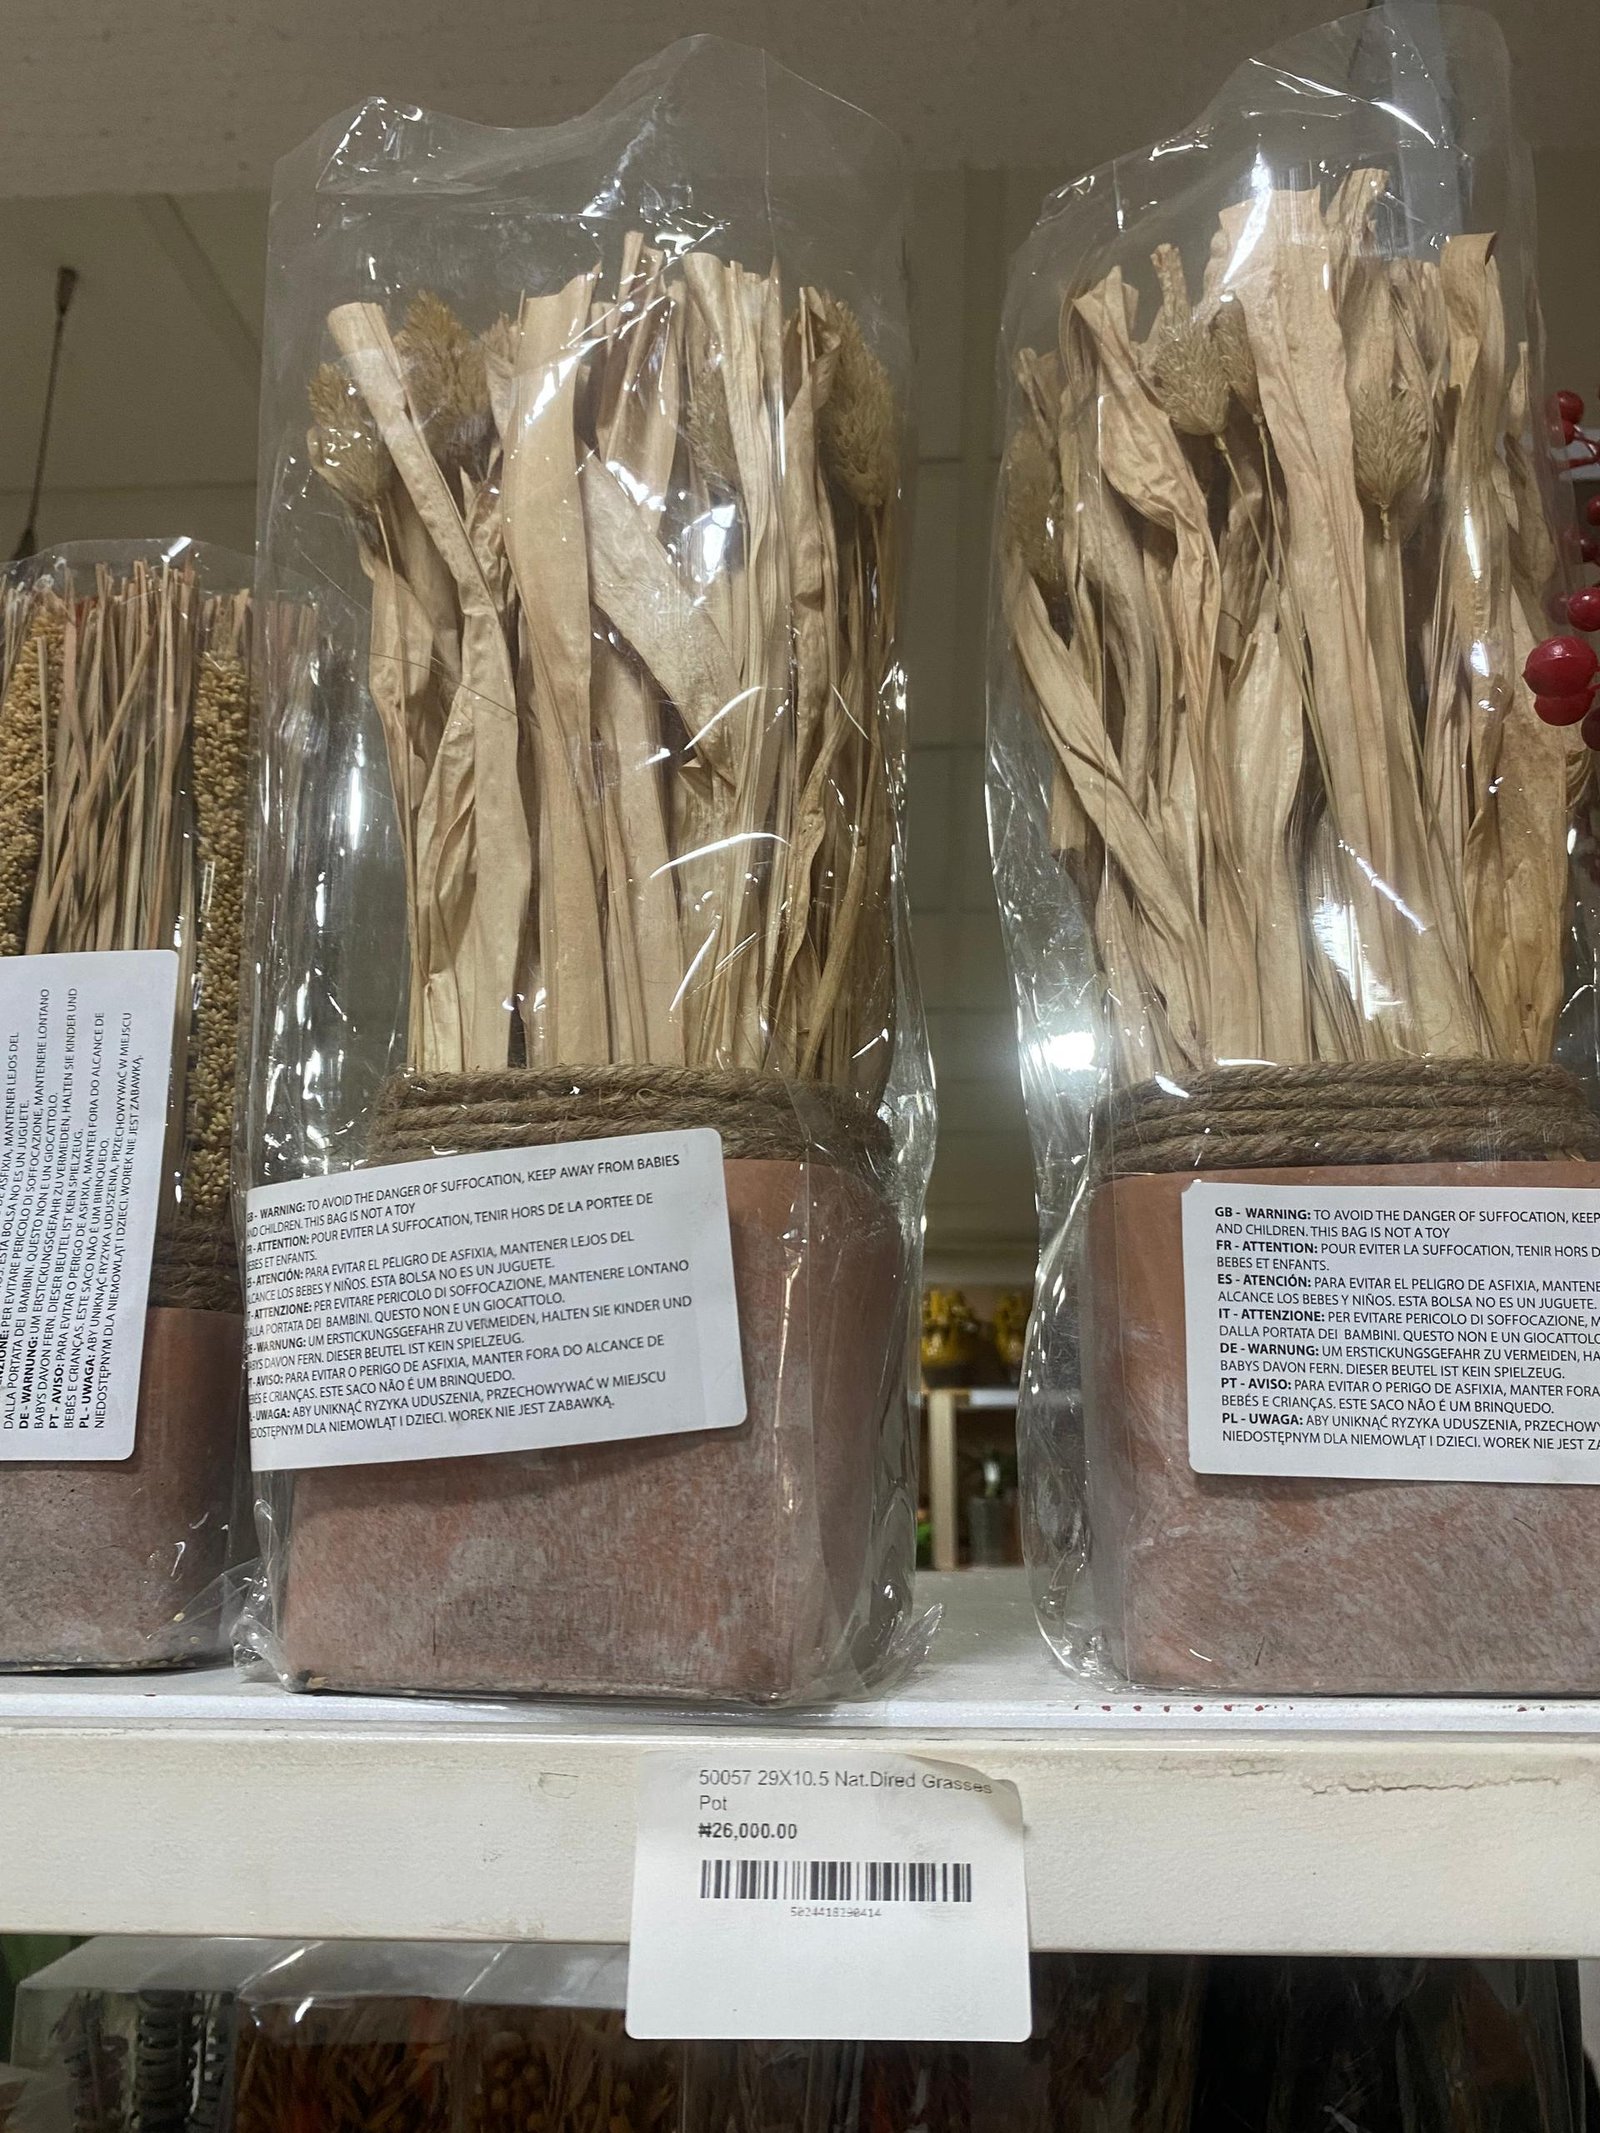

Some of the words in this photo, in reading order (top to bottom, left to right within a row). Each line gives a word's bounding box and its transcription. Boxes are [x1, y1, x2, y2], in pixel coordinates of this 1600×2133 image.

[94, 1013, 104, 1027] DE
[118, 1013, 132, 1057] MIEJSCU
[90, 1030, 103, 1078] ALCANCE
[89, 1080, 99, 1097] DO
[87, 1099, 97, 1128] FORA
[128, 1113, 138, 1136] JEST
[81, 1130, 95, 1175] MANTER
[124, 1139, 136, 1156] NIE
[119, 1158, 134, 1197] WOREK
[257, 1235, 309, 1252] ATTENTION:
[310, 1228, 339, 1244] POUR
[339, 1224, 374, 1240] EVITER
[375, 1222, 390, 1235] LA
[391, 1212, 473, 1234] SUFFOCATION,
[473, 1208, 508, 1224] TENIR
[510, 1204, 545, 1219] HORS
[547, 1202, 564, 1216] DE
[566, 1200, 583, 1212] LA
[585, 1194, 633, 1210] PORTEE
[635, 1192, 653, 1205] DE
[303, 1214, 326, 1228] THIS
[326, 1211, 348, 1225] BAG
[349, 1209, 358, 1222] IS
[360, 1206, 383, 1220] NOT
[384, 1205, 392, 1218] A
[393, 1202, 415, 1216] TOY
[1214, 1206, 1233, 1218] GB
[1245, 1206, 1311, 1219] WARNING:
[1312, 1207, 1330, 1219] TO
[1333, 1207, 1373, 1220] AVOID
[1374, 1208, 1400, 1220] THE
[1402, 1208, 1456, 1221] DANGER
[1458, 1209, 1476, 1222] OF
[1478, 1210, 1569, 1225] SUFFOCATION,
[1571, 1211, 1600, 1224] KEEP
[74, 1223, 86, 1237] DE
[1215, 1223, 1242, 1235] AND
[1245, 1223, 1308, 1236] CHILDREN.
[1309, 1224, 1338, 1237] THIS
[1341, 1225, 1367, 1238] BAG
[1370, 1226, 1381, 1238] IS
[1384, 1226, 1411, 1238] NOT
[1413, 1226, 1423, 1239] A
[1424, 1227, 1450, 1239] TOY
[67, 1240, 84, 1279] PERIGO
[97, 1232, 112, 1275] RYZYKA
[304, 1264, 330, 1278] PARA
[331, 1260, 366, 1275] EVITAR
[367, 1258, 380, 1270] EL
[381, 1253, 429, 1270] PELIGRO
[431, 1250, 447, 1264] DE
[449, 1246, 499, 1262] ASFIXIA,
[500, 1237, 568, 1255] MANTENER
[570, 1233, 608, 1248] LEJOS
[610, 1230, 634, 1244] DEL
[1216, 1256, 1253, 1269] BEBES
[1255, 1257, 1270, 1269] ET
[1272, 1257, 1330, 1271] ENFANTS.
[254, 1302, 311, 1319] ATTENZIONE:
[312, 1298, 332, 1312] PER
[332, 1293, 375, 1309] EVITARE
[376, 1288, 432, 1305] PERICOLO
[434, 1286, 447, 1298] DI
[448, 1275, 548, 1297] SOFFOCAZIONE,
[548, 1266, 624, 1286] MANTENERE
[627, 1259, 689, 1277] LONTANO
[1217, 1290, 1274, 1304] ALCANCE
[1276, 1292, 1299, 1304] LOS
[1302, 1292, 1339, 1305] BEBES
[1340, 1293, 1349, 1305] Y
[1352, 1291, 1396, 1306] NIÑOS.
[1398, 1294, 1428, 1307] ESTA
[1430, 1295, 1473, 1308] BOLSA
[1475, 1296, 1496, 1308] NO
[1498, 1296, 1514, 1309] ES
[1516, 1297, 1535, 1309] UN
[1538, 1297, 1597, 1310] JUGUETE.
[59, 1293, 75, 1330] EVITAR
[102, 1314, 116, 1337] DLA
[256, 1338, 306, 1352] WARNUNG:
[307, 1334, 325, 1347] UM
[325, 1322, 445, 1345] ERSTICKUNGSGEFAHR
[446, 1320, 463, 1334] ZU
[464, 1312, 541, 1331] VERMEIDEN,
[541, 1306, 590, 1322] HALTEN
[592, 1304, 610, 1317] SIE
[613, 1298, 660, 1315] KINDER
[662, 1295, 692, 1309] UND
[1219, 1325, 1260, 1338] DALLA
[1262, 1326, 1315, 1339] PORTATA
[1318, 1327, 1338, 1339] DEI
[1343, 1327, 1401, 1341] BAMBINI.
[1402, 1329, 1454, 1343] QUESTO
[1457, 1330, 1487, 1342] NON
[1490, 1330, 1498, 1343] E
[1500, 1331, 1520, 1343] UN
[54, 1332, 69, 1362] PARA
[86, 1330, 98, 1352] ABY
[80, 1356, 96, 1405] UWAGA:
[1220, 1360, 1259, 1373] BABYS
[1262, 1361, 1306, 1374] DAVON
[1308, 1362, 1344, 1375] FERN.
[1345, 1362, 1388, 1375] DIESER
[1390, 1363, 1438, 1376] BEUTEL
[1440, 1364, 1459, 1377] IST
[1461, 1365, 1491, 1378] KEIN
[1493, 1366, 1565, 1379] SPIELZEUG.
[50, 1362, 65, 1405] AVISO:
[1221, 1393, 1259, 1407] BEBÉS
[1261, 1395, 1270, 1408] E
[1271, 1396, 1337, 1411] CRIANÇAS.
[1338, 1397, 1367, 1410] ESTE
[1369, 1398, 1404, 1411] SACO
[1407, 1397, 1436, 1411] NÃO
[1448, 1400, 1471, 1412] UM
[1474, 1400, 1555, 1415] BRINQUEDO.
[48, 1414, 60, 1429] PT
[78, 1414, 90, 1429] PL
[1222, 1430, 1320, 1446] NIEDOSTĘPNYM
[1322, 1432, 1348, 1445] DLA
[1350, 1433, 1427, 1449] NIEMOWLĄT
[1428, 1435, 1433, 1446] I
[1436, 1435, 1481, 1448] DZIECI.
[1482, 1436, 1531, 1449] WOREK
[1533, 1437, 1554, 1449] NIE
[1556, 1437, 1584, 1450] JEST
[699, 1769, 752, 1786] 50057
[757, 1770, 830, 1787] 29X10.5
[835, 1771, 916, 1788] Nat.Dired
[922, 1774, 993, 1795] Grasses
[699, 1794, 728, 1811] Pot
